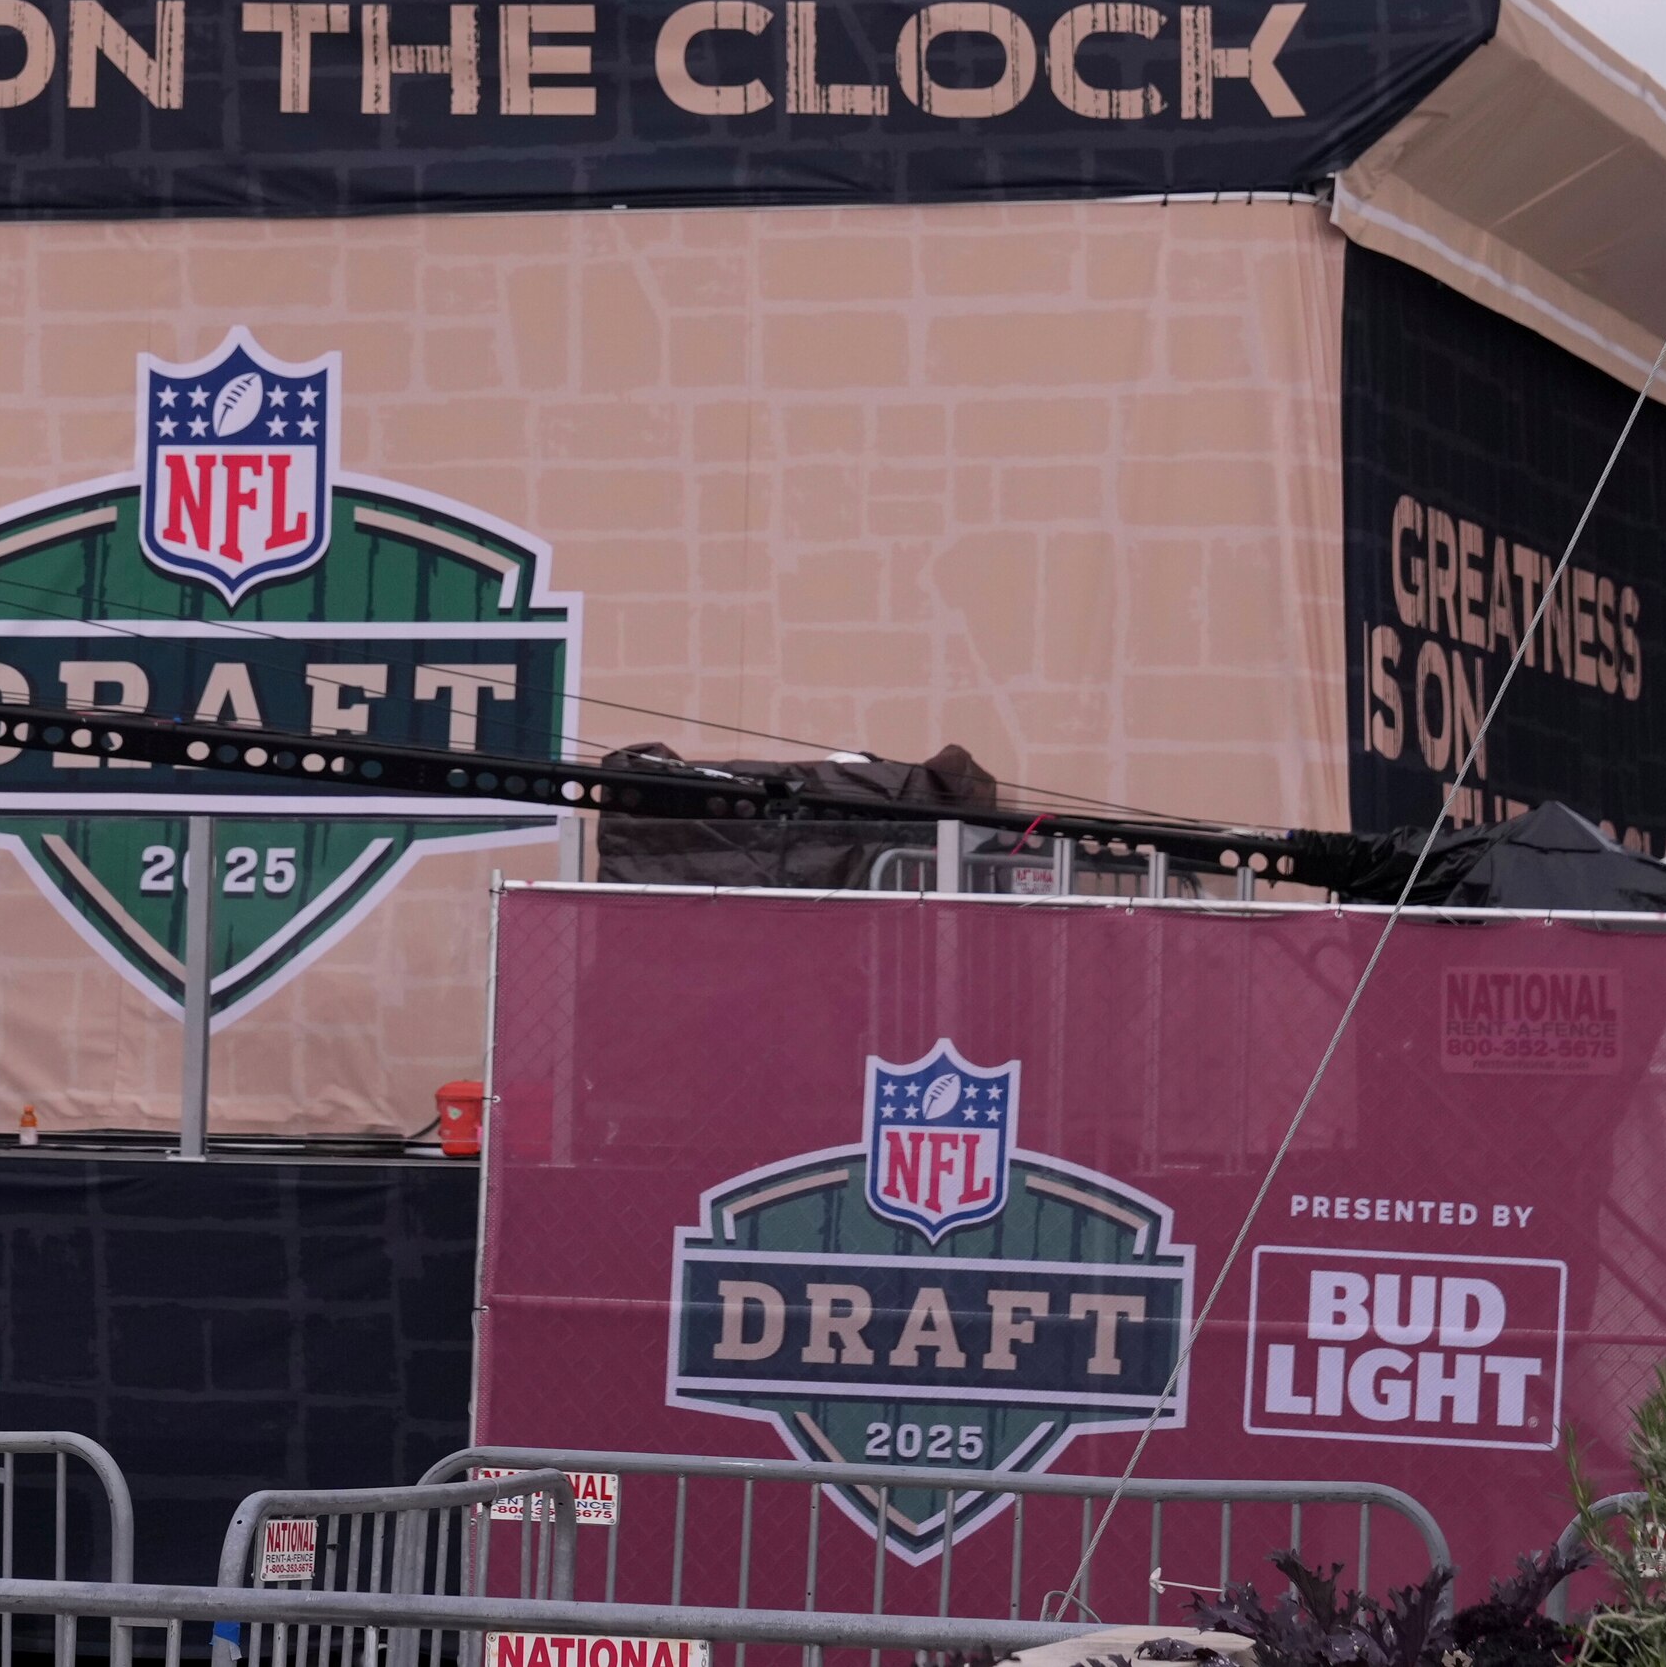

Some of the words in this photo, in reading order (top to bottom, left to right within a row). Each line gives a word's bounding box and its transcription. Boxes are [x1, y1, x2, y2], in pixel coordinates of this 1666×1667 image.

[242, 1, 597, 116] THE
[654, 0, 1307, 120] CLOCK
[162, 454, 308, 563] NFL
[1391, 494, 1641, 702] GREATNESS
[1363, 620, 1405, 761] IS
[1416, 639, 1487, 781] ON
[139, 844, 297, 894] 225
[1446, 973, 1617, 1022] NATIONAL
[1446, 1021, 1617, 1038] RENT-A-FENCE
[882, 1131, 993, 1214] NFL
[1290, 1195, 1479, 1226] PRESENTED
[1492, 1205, 1534, 1228] BY
[712, 1279, 1147, 1376] DRAFT
[1307, 1269, 1507, 1349] BUD
[1264, 1343, 1543, 1428] LIGHT
[864, 1422, 985, 1460] 2025
[265, 1553, 314, 1564] RENT-A-FENCE
[266, 1522, 315, 1552] NATIONAL
